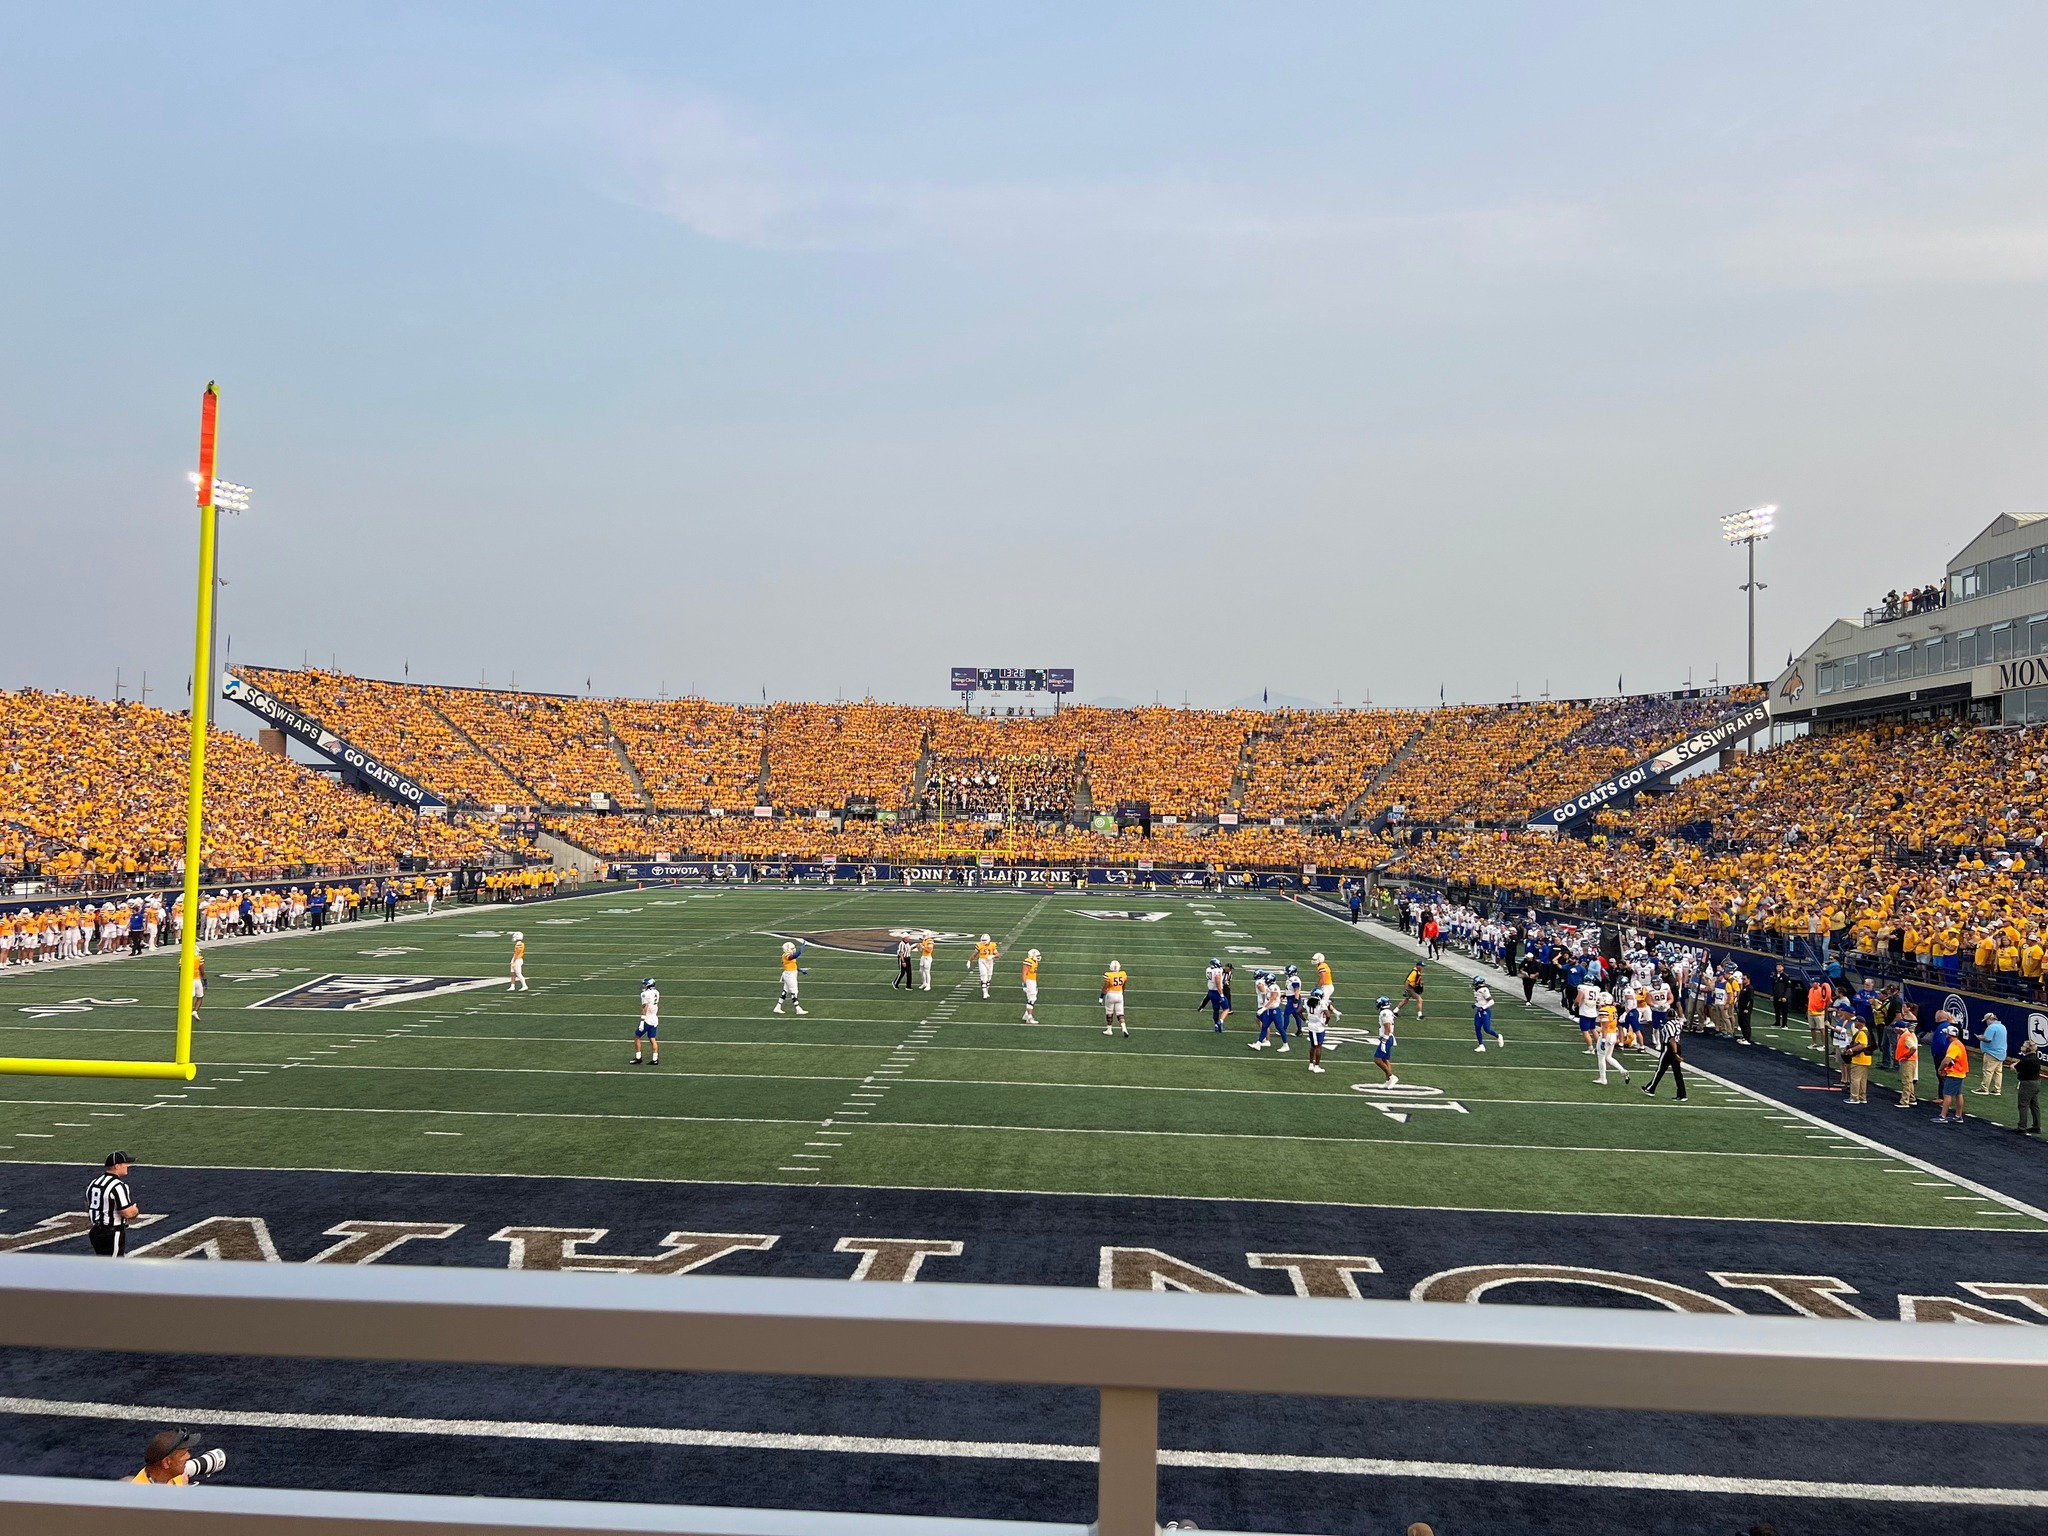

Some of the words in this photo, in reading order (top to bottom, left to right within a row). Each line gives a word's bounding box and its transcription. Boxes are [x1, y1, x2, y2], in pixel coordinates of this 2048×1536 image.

[1699, 686, 1726, 698] PEPSI
[344, 749, 365, 768] GO
[365, 761, 400, 789] CATS
[399, 781, 424, 804] GO!
[1553, 803, 1577, 823] GO
[1577, 783, 1618, 811] CATS
[1618, 767, 1647, 791] GO!
[664, 867, 699, 875] TOYOTA
[1030, 870, 1070, 881] ZONE
[1113, 977, 1123, 987] 55
[1588, 990, 1597, 1001] 51
